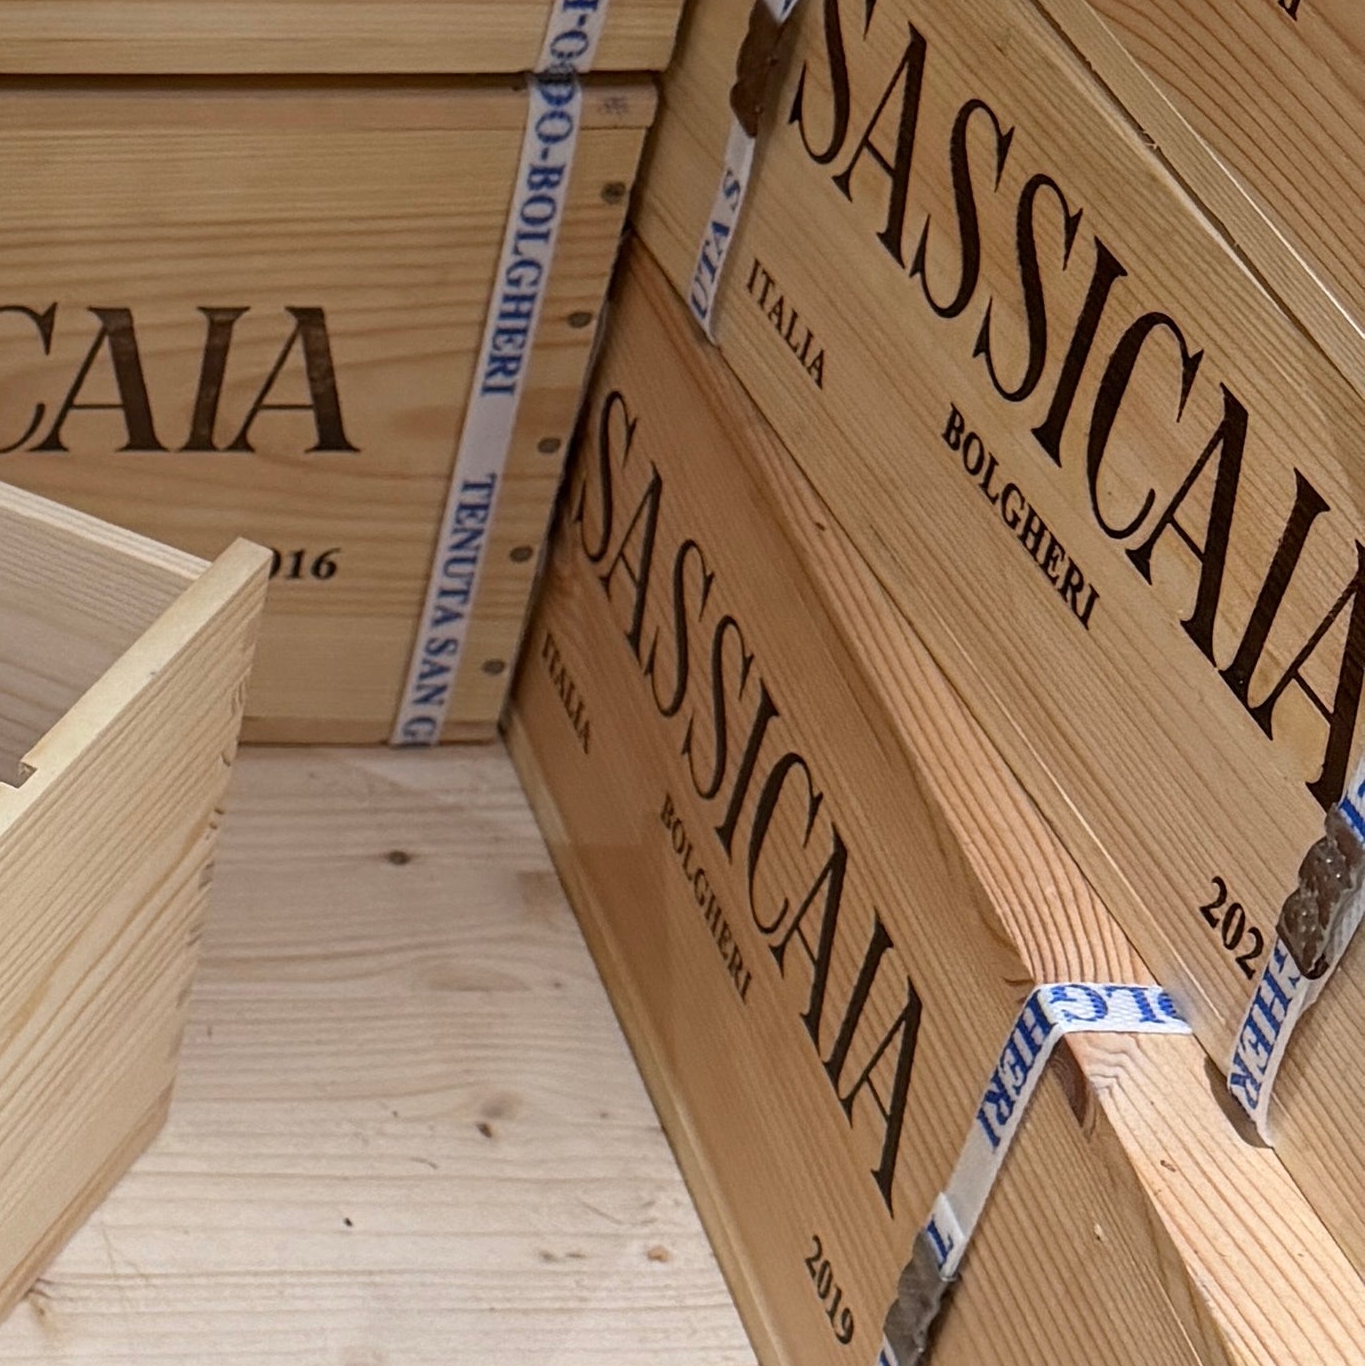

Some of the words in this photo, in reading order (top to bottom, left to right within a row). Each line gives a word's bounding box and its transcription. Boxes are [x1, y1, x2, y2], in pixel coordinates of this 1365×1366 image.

[746, 256, 827, 391] ITALIA
[429, 473, 497, 627] TENUTA
[941, 401, 1101, 631] BOLGHERI
[411, 638, 459, 720] SAN
[572, 389, 923, 1219] SASSICAIA
[661, 791, 752, 1005] BOLGHERI
[803, 1234, 855, 1346] 2019
